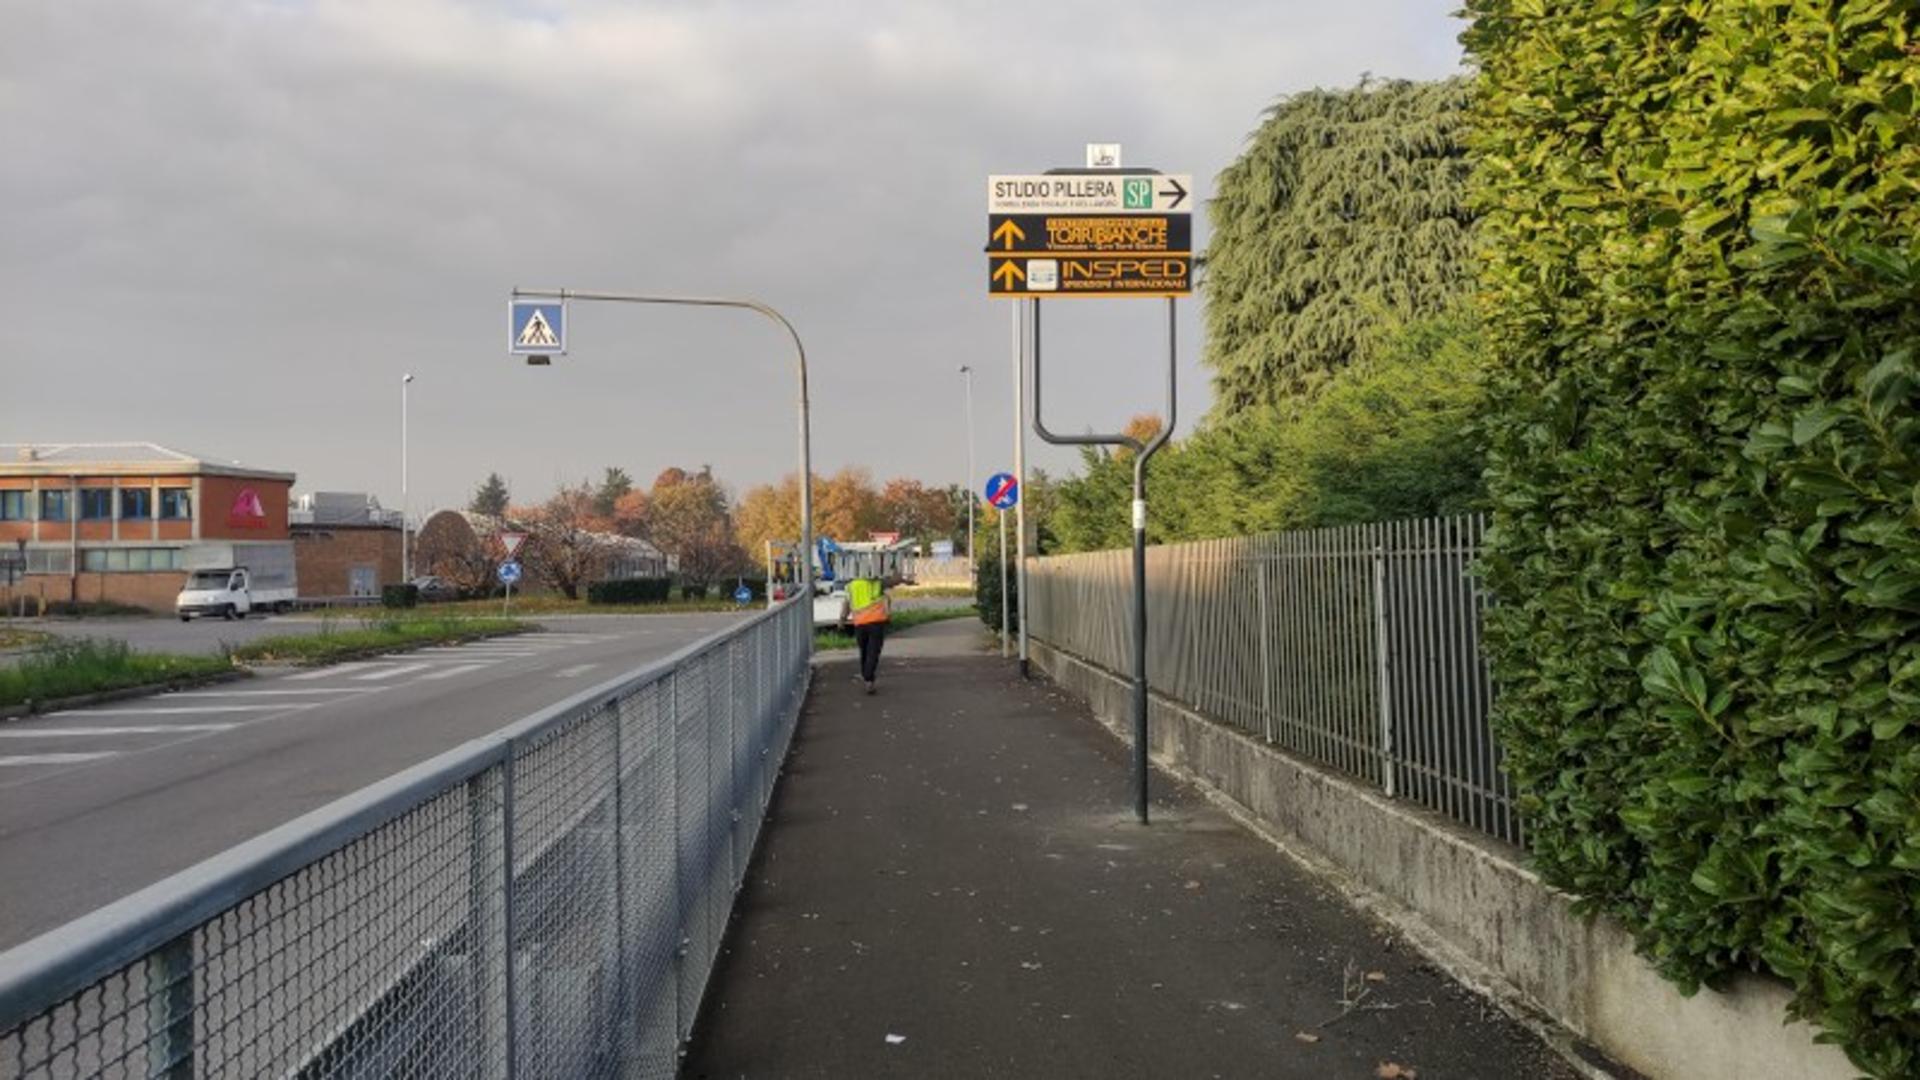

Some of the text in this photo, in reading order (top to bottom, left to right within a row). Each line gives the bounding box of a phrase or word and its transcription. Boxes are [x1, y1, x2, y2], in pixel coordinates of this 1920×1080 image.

[995, 181, 1116, 198] STUDIO PILLERA
[1127, 181, 1148, 208] SP
[1062, 260, 1186, 278] INSPED
